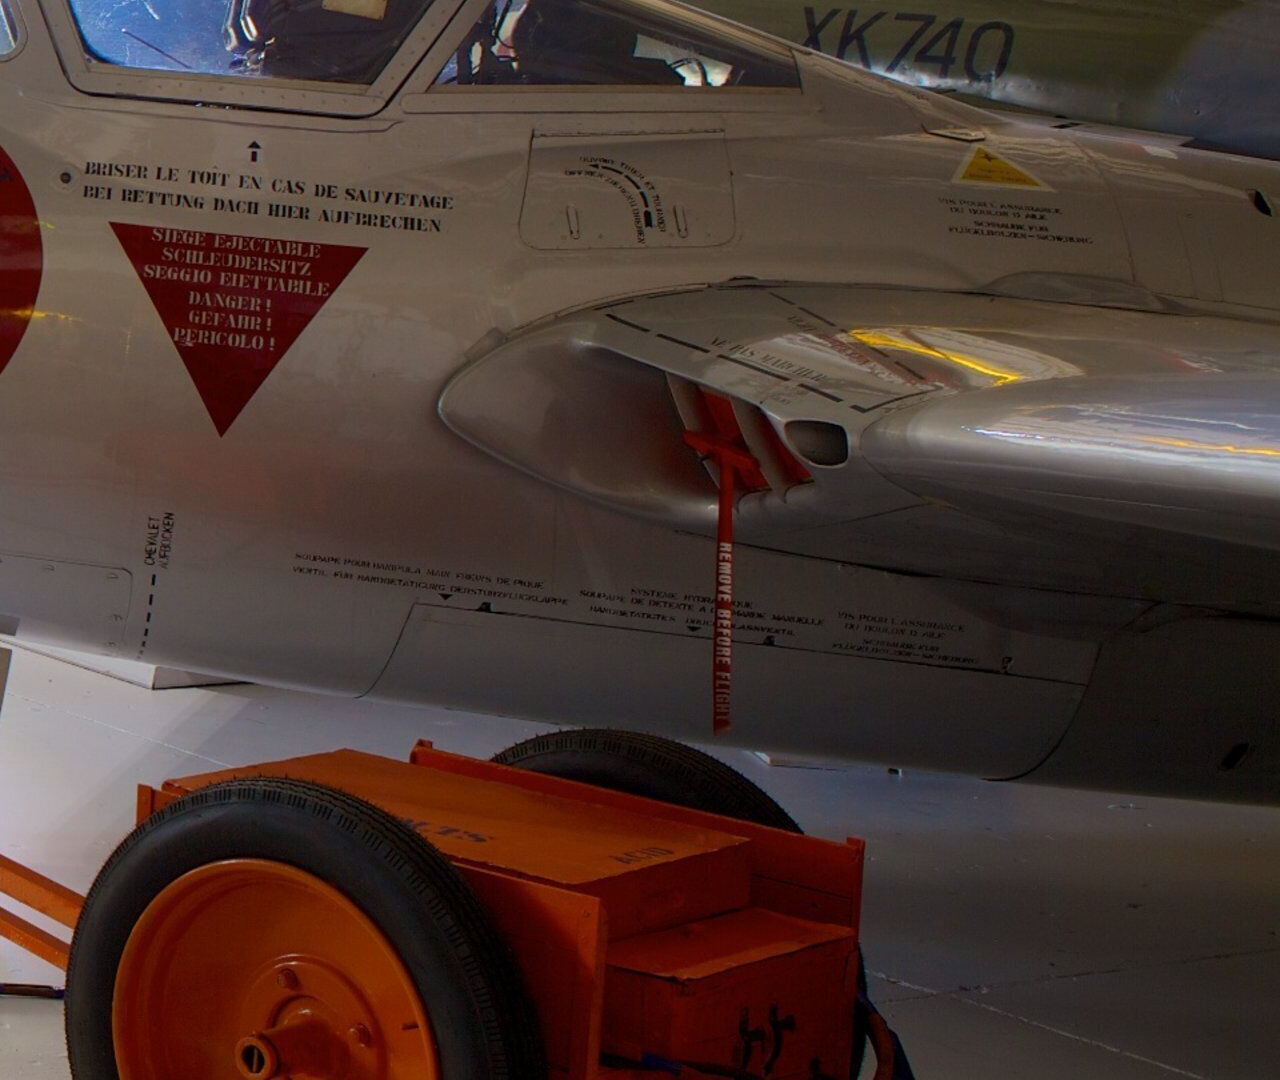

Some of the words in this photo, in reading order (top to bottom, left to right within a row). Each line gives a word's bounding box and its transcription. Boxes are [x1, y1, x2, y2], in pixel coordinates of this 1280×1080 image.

[802, 6, 1015, 83] XK740
[83, 184, 114, 201] BEI
[121, 187, 205, 211] RETTUNG
[213, 196, 260, 216] DACH
[267, 202, 311, 221] HIER
[318, 207, 443, 234] AUFBRECHEN
[84, 160, 149, 181] BRISER
[157, 166, 180, 183] LE
[239, 174, 263, 191] EN
[271, 178, 307, 197] CAS
[314, 182, 339, 200] DE
[344, 186, 455, 211] SAUVETAGE
[151, 227, 207, 246] SIEGE
[213, 233, 322, 260] EJECTABLE
[160, 246, 312, 277] SCHLEUDERSITZ
[142, 263, 213, 285] SEGGIO
[218, 272, 331, 299] EIETTABILE
[188, 291, 262, 312] DANGER
[173, 326, 265, 351] PERICOLO
[188, 309, 262, 331] GEFAHR
[144, 516, 160, 566] CHEVALET
[717, 542, 733, 603] REMOVE
[716, 609, 732, 665] BEFORE
[715, 672, 731, 719] FLIGHT
